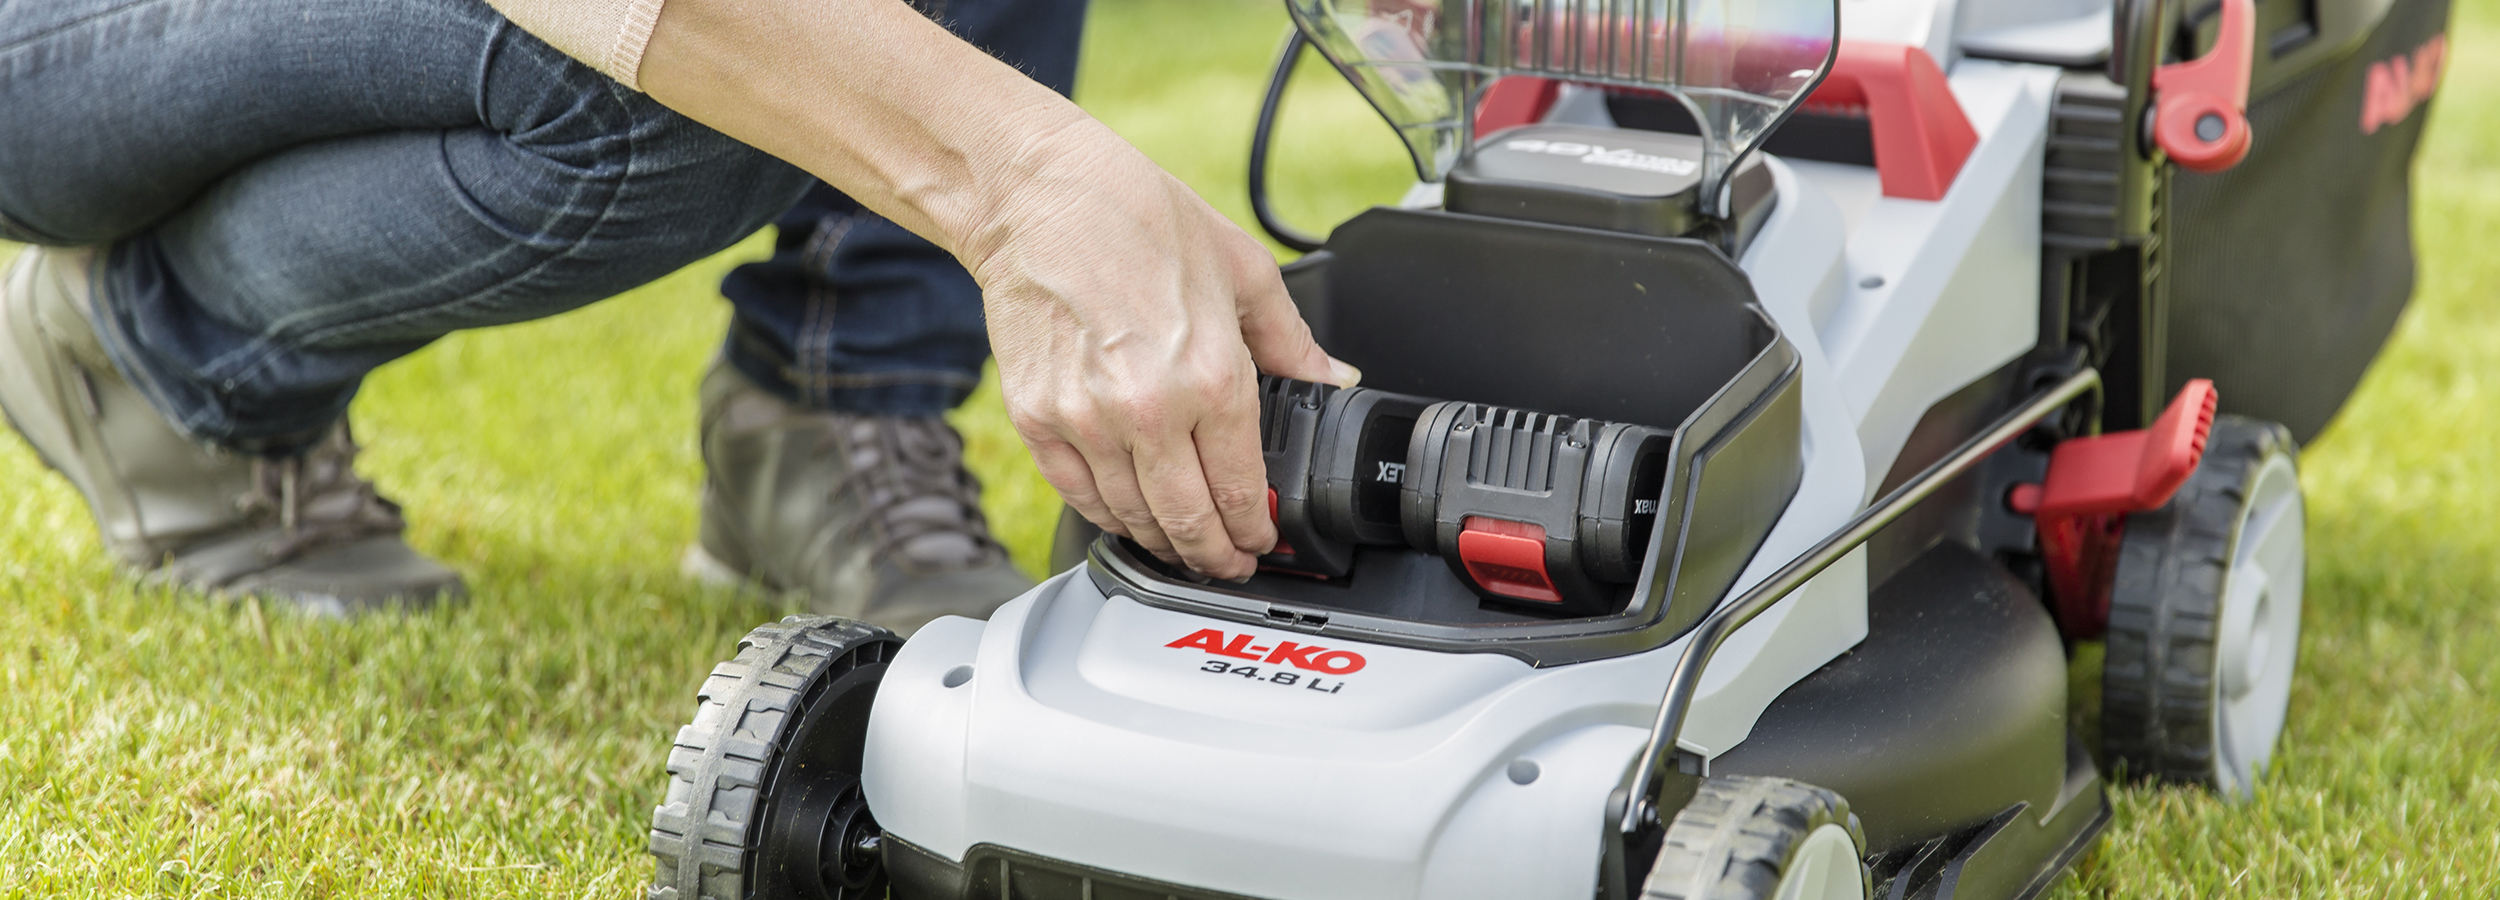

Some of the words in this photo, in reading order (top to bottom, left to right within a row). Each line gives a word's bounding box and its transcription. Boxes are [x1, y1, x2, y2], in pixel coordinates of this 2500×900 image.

[1164, 628, 1367, 675] AL-KO
[1201, 660, 1301, 685] 34.8
[1307, 678, 1345, 693] Li
